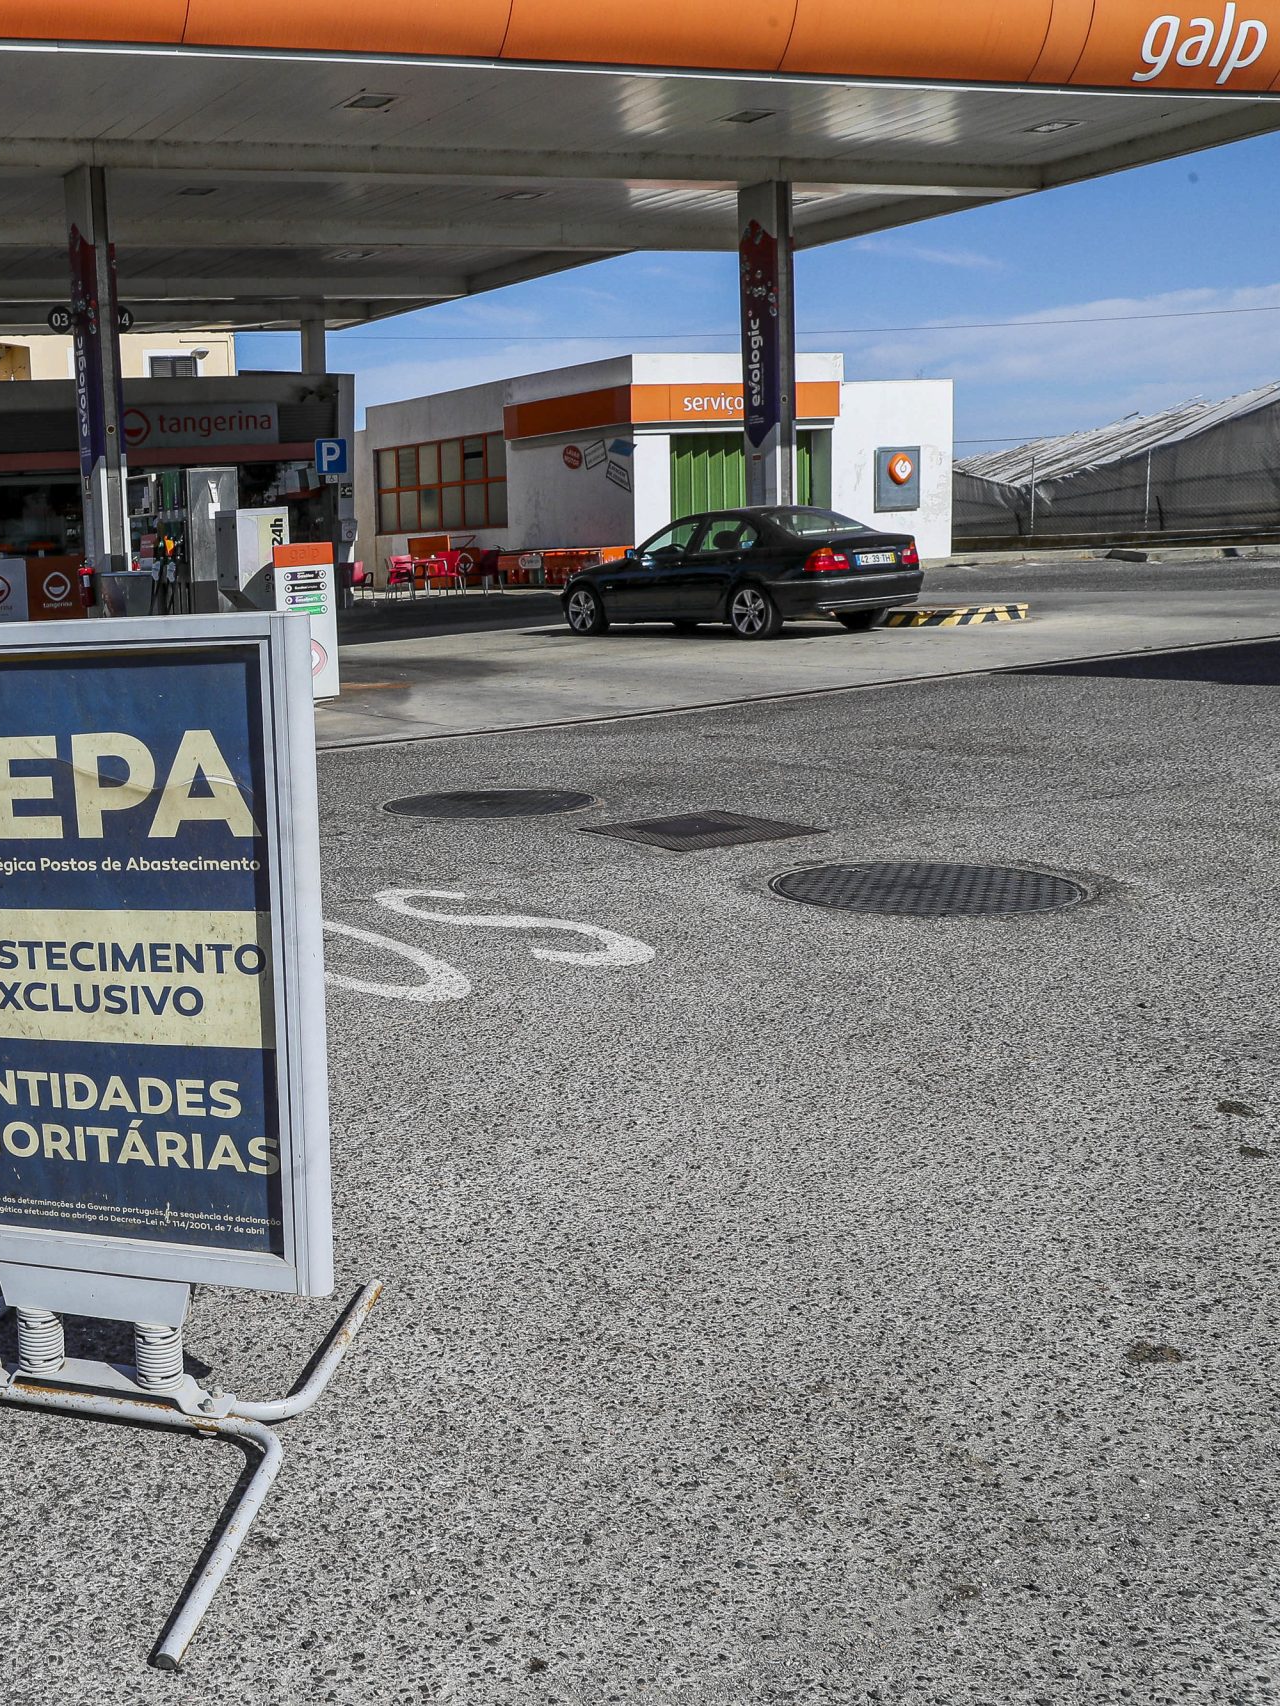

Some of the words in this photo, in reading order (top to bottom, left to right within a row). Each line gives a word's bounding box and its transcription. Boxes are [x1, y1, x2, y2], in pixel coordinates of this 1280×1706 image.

[1131, 2, 1268, 85] galp
[52, 313, 69, 327] 03
[118, 313, 130, 326] 4
[748, 318, 764, 407] evologic
[76, 336, 89, 437] evologic
[157, 410, 273, 438] tangerina
[322, 442, 341, 472] P
[270, 517, 284, 546] 24h
[43, 600, 73, 609] tangerina
[40, 857, 97, 872] Postos
[101, 857, 122, 871] de
[126, 856, 261, 872] Abastecimento
[2, 1195, 16, 1204] das
[17, 1197, 74, 1209] determinações
[87, 1202, 121, 1213] Governo
[180, 1210, 222, 1222] sequência
[223, 1213, 234, 1222] de
[235, 1214, 281, 1227] declaração
[24, 1207, 60, 1218] efetuada
[60, 1210, 71, 1218] ao
[71, 1211, 97, 1222] abrigo
[98, 1213, 109, 1222] do
[110, 1214, 158, 1227] Decreto-Lei
[172, 1220, 213, 1232] 114/2001,
[214, 1223, 226, 1232] de
[233, 1225, 244, 1233] de
[245, 1226, 265, 1235] abril
